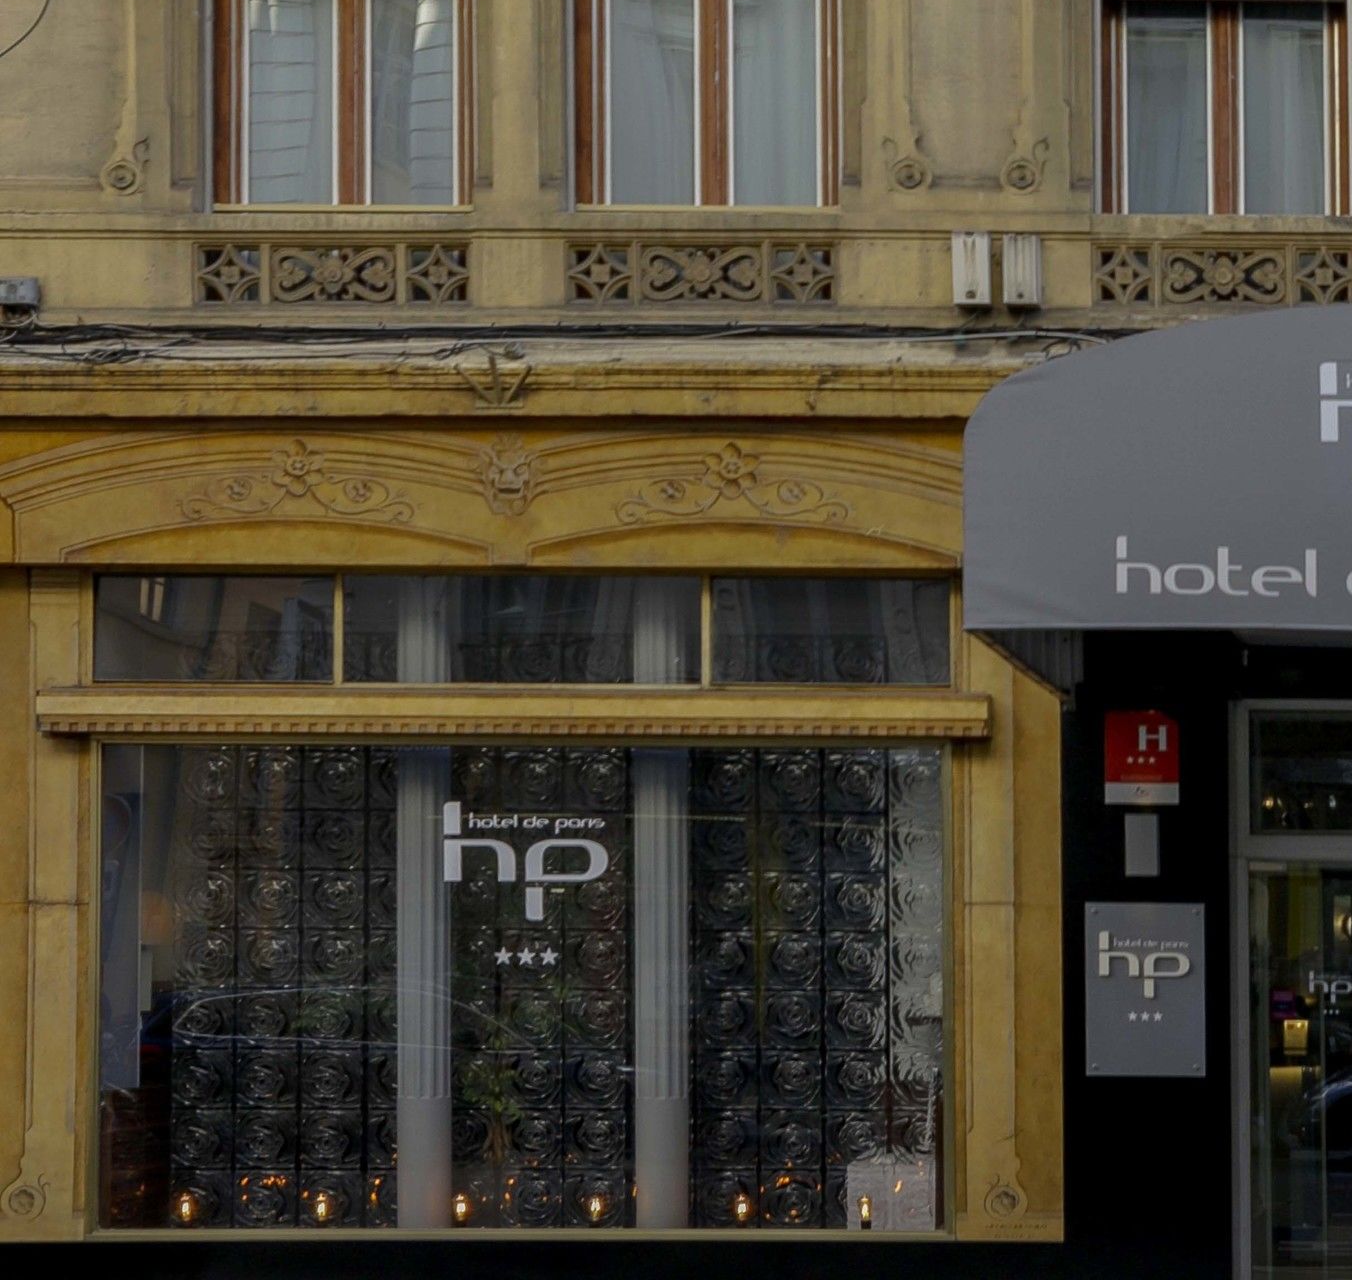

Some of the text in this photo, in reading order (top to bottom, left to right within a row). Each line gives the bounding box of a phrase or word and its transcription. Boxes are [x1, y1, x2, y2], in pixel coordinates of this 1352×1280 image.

[1116, 536, 1317, 598] hotel
[1138, 725, 1168, 752] H
[468, 812, 606, 835] hotel de paris
[443, 801, 609, 922] hp
[1098, 931, 1190, 999] hp
[1308, 970, 1352, 1004] hp
